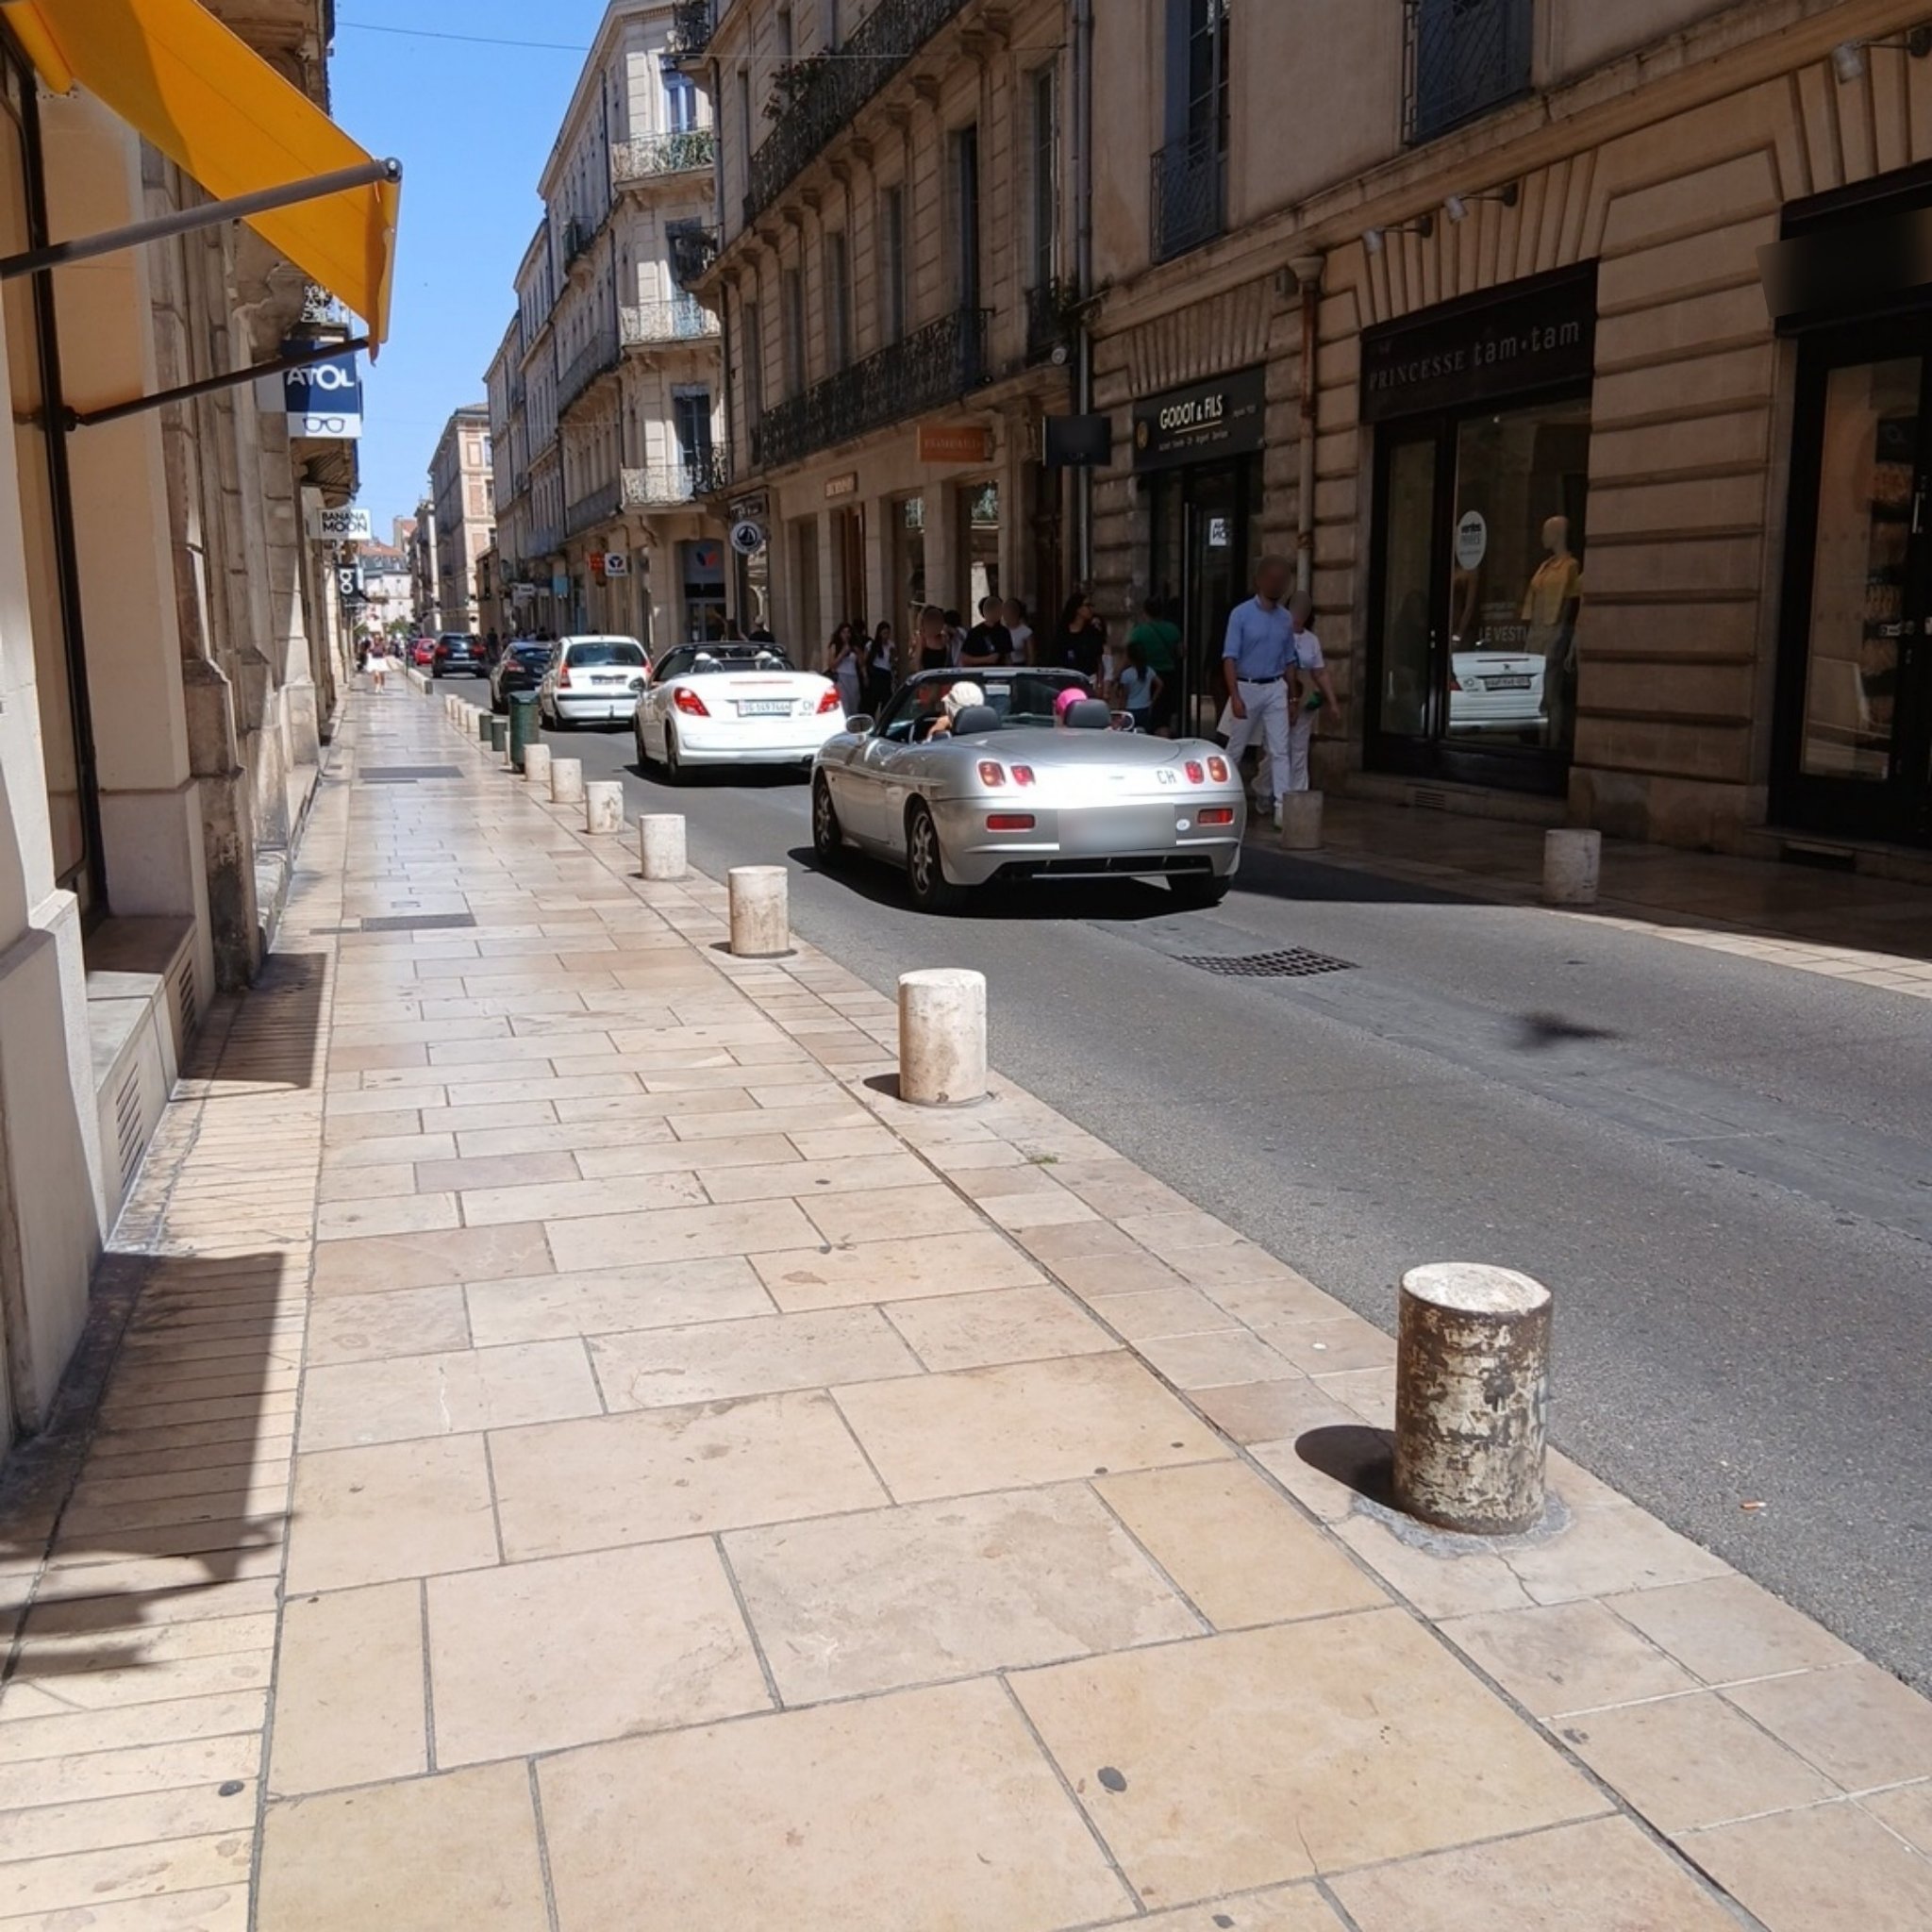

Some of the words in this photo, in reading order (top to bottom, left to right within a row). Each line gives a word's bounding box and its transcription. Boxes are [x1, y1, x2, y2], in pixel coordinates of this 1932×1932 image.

[287, 364, 355, 391] ATOL
[1368, 350, 1465, 391] PRINCESSE
[1159, 401, 1196, 430] GODOT
[1196, 404, 1204, 422] &
[1204, 393, 1224, 420] FILS
[322, 511, 366, 522] BANANA
[323, 521, 368, 533] MOON
[1157, 770, 1177, 785] CH
